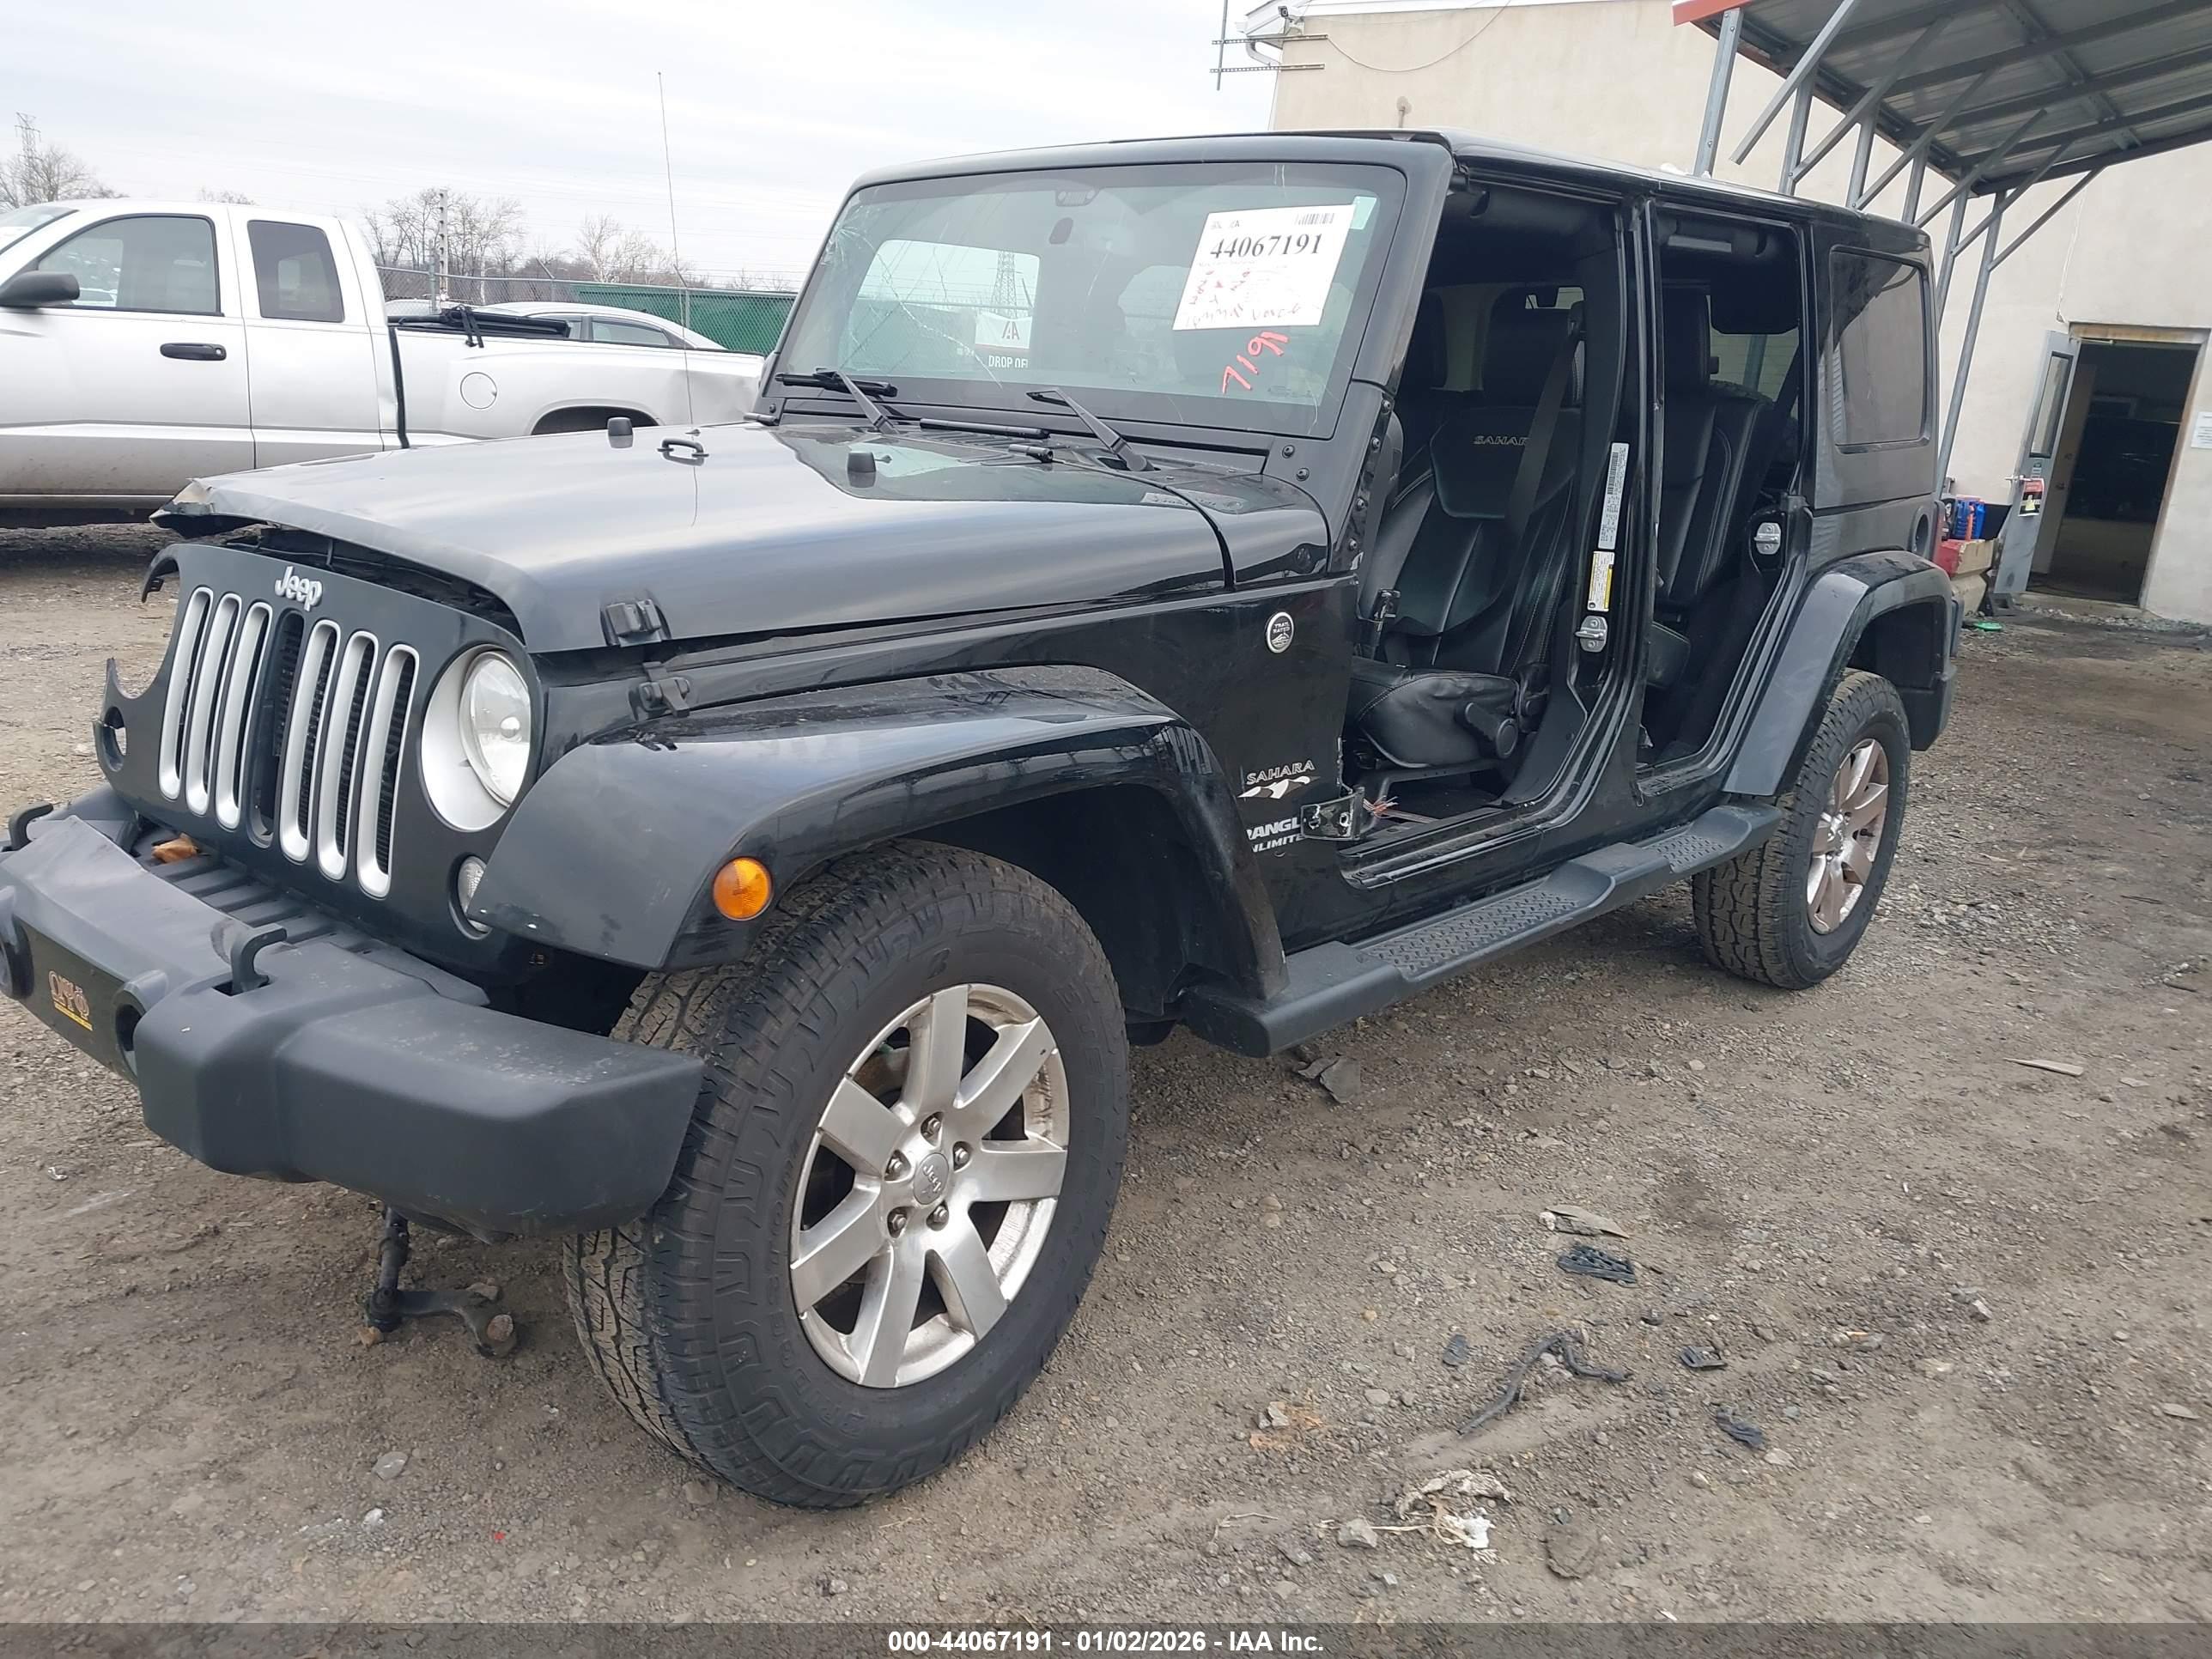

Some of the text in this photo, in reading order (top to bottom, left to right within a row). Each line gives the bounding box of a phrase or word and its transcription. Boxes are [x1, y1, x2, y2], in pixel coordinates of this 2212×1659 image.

[1210, 234, 1323, 258] 44067191
[988, 355, 1013, 368] DROP
[1222, 331, 1289, 393] 7191
[275, 566, 322, 611] Jeep
[1246, 759, 1316, 785] SAHARA
[1245, 816, 1301, 841] ANGL
[1251, 832, 1306, 853] NLIMITE
[922, 1164, 942, 1194] Jeep
